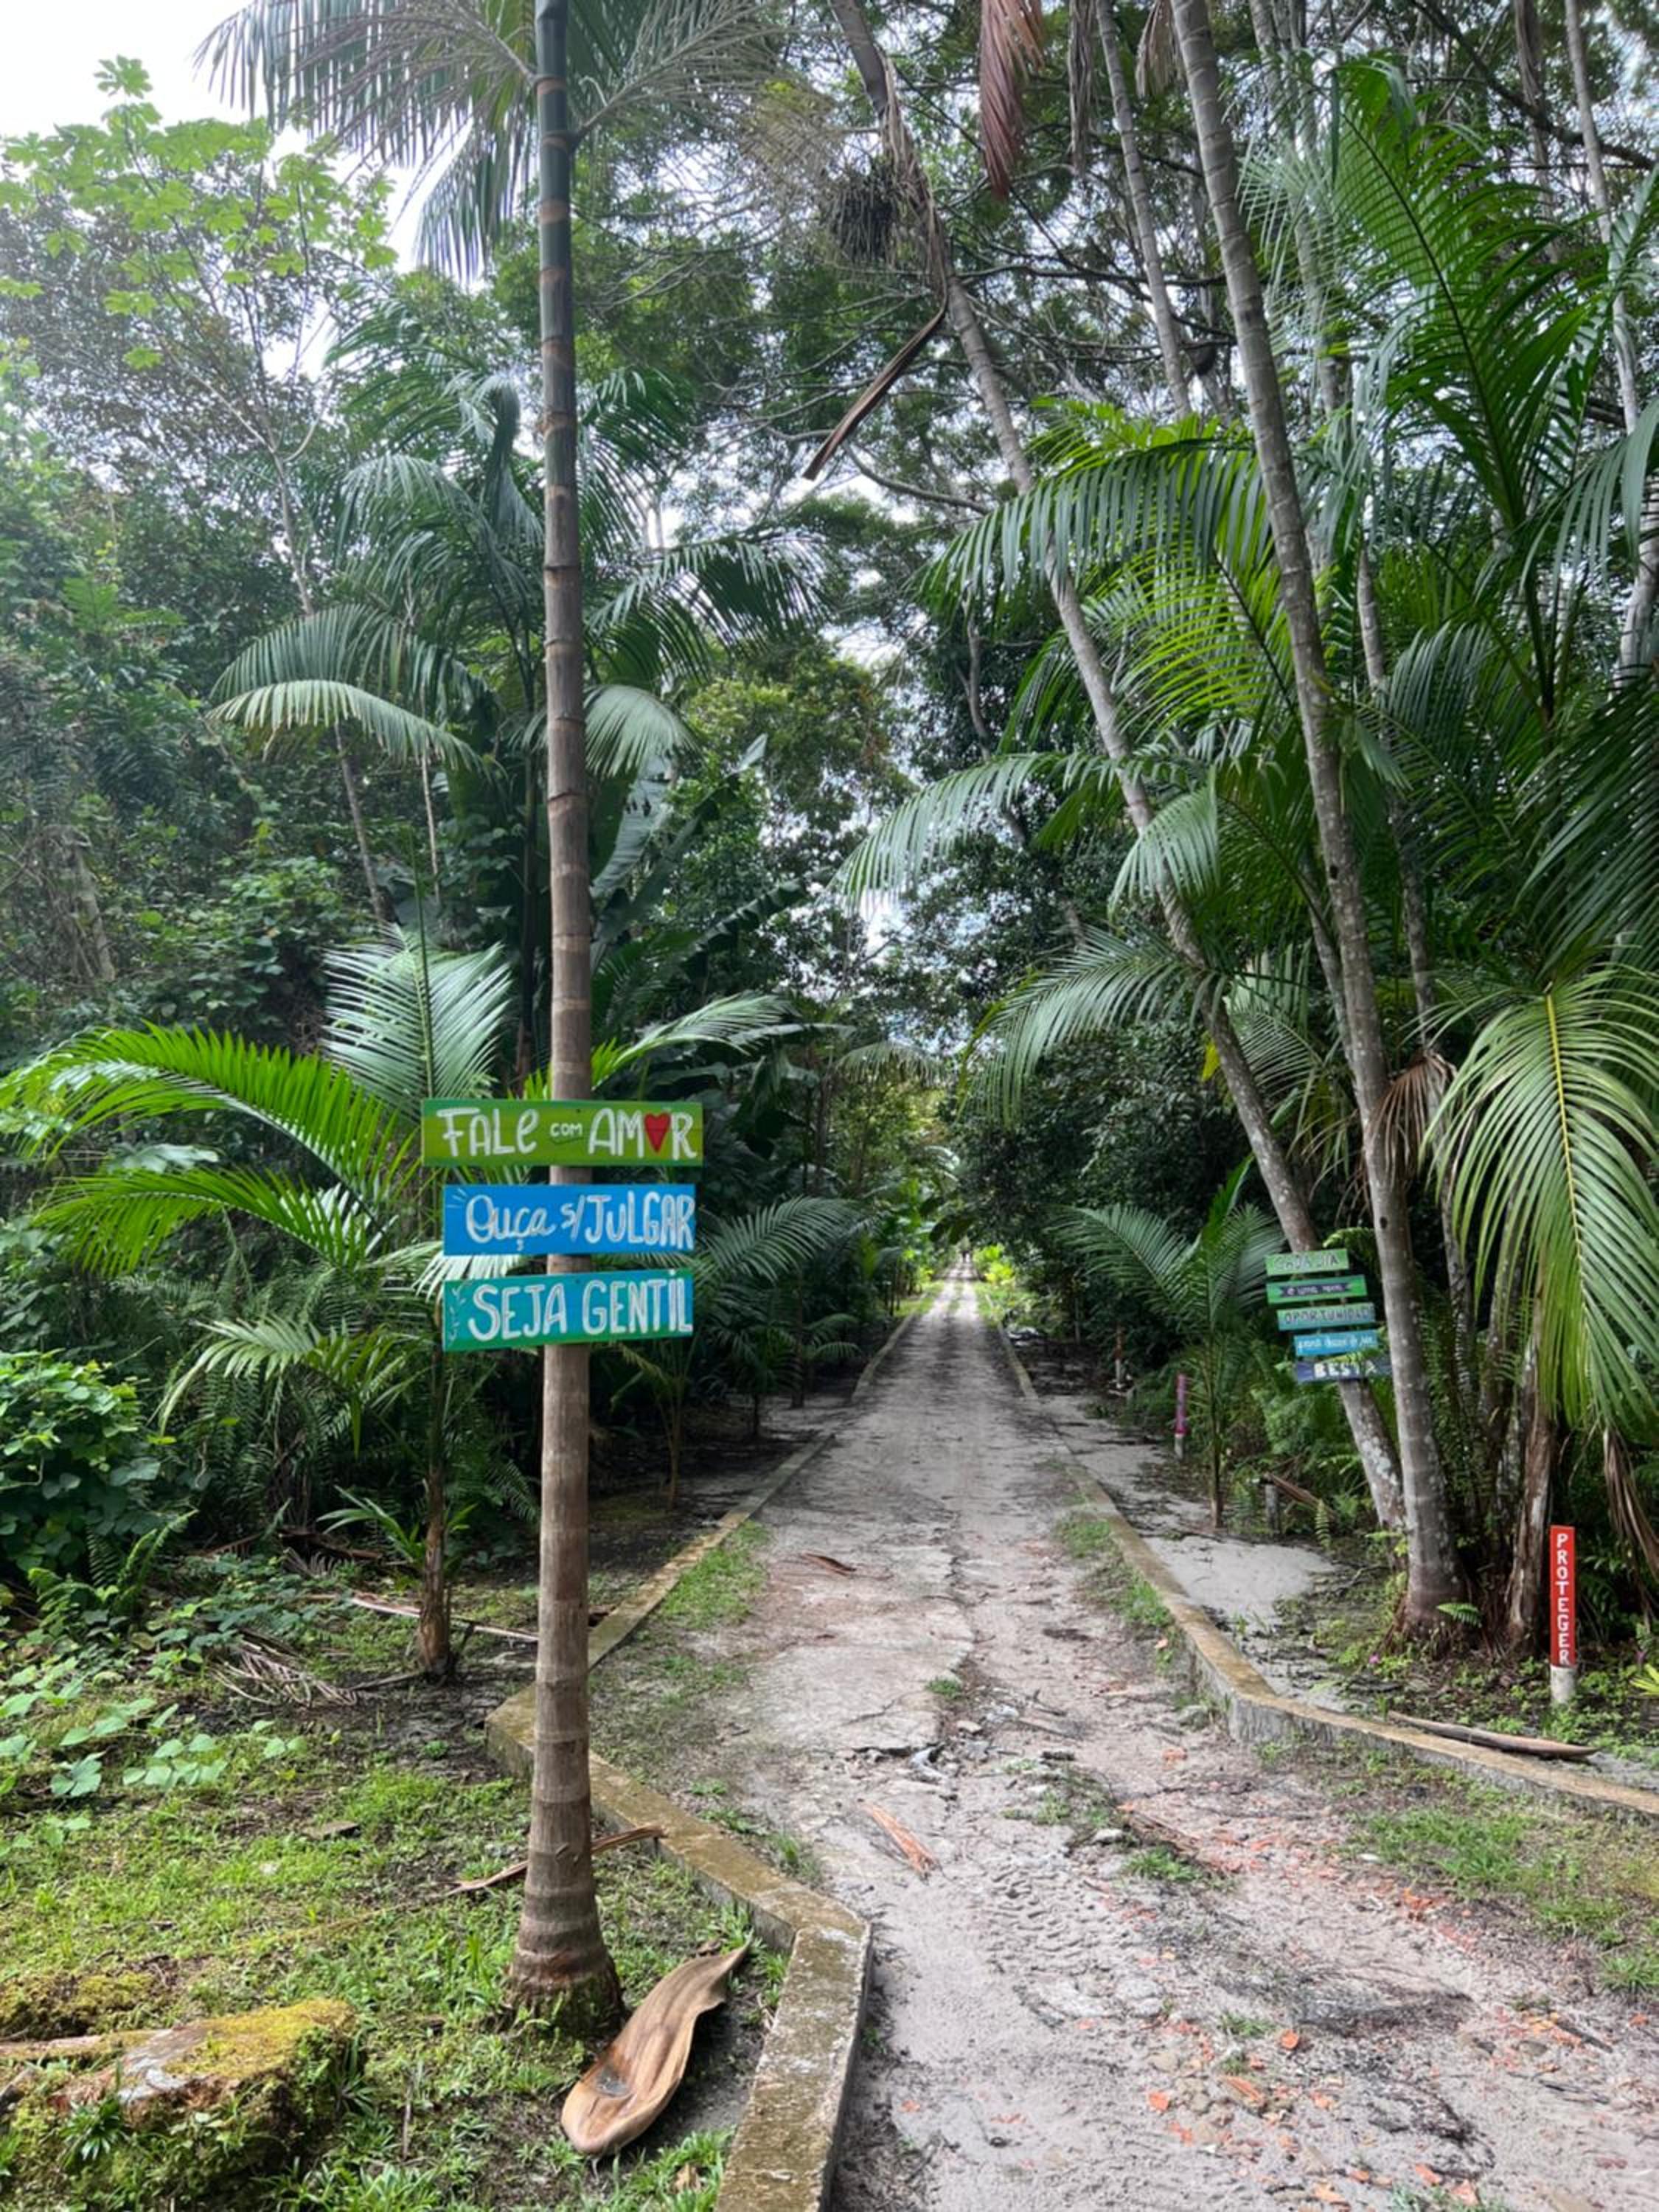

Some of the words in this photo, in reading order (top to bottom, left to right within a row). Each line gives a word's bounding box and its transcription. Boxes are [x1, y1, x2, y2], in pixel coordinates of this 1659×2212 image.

[465, 1194, 555, 1251] Ouça
[467, 1283, 567, 1342] SEJA
[582, 1269, 693, 1335] GENTIL
[1556, 1534, 1571, 1666] PROTEGER
